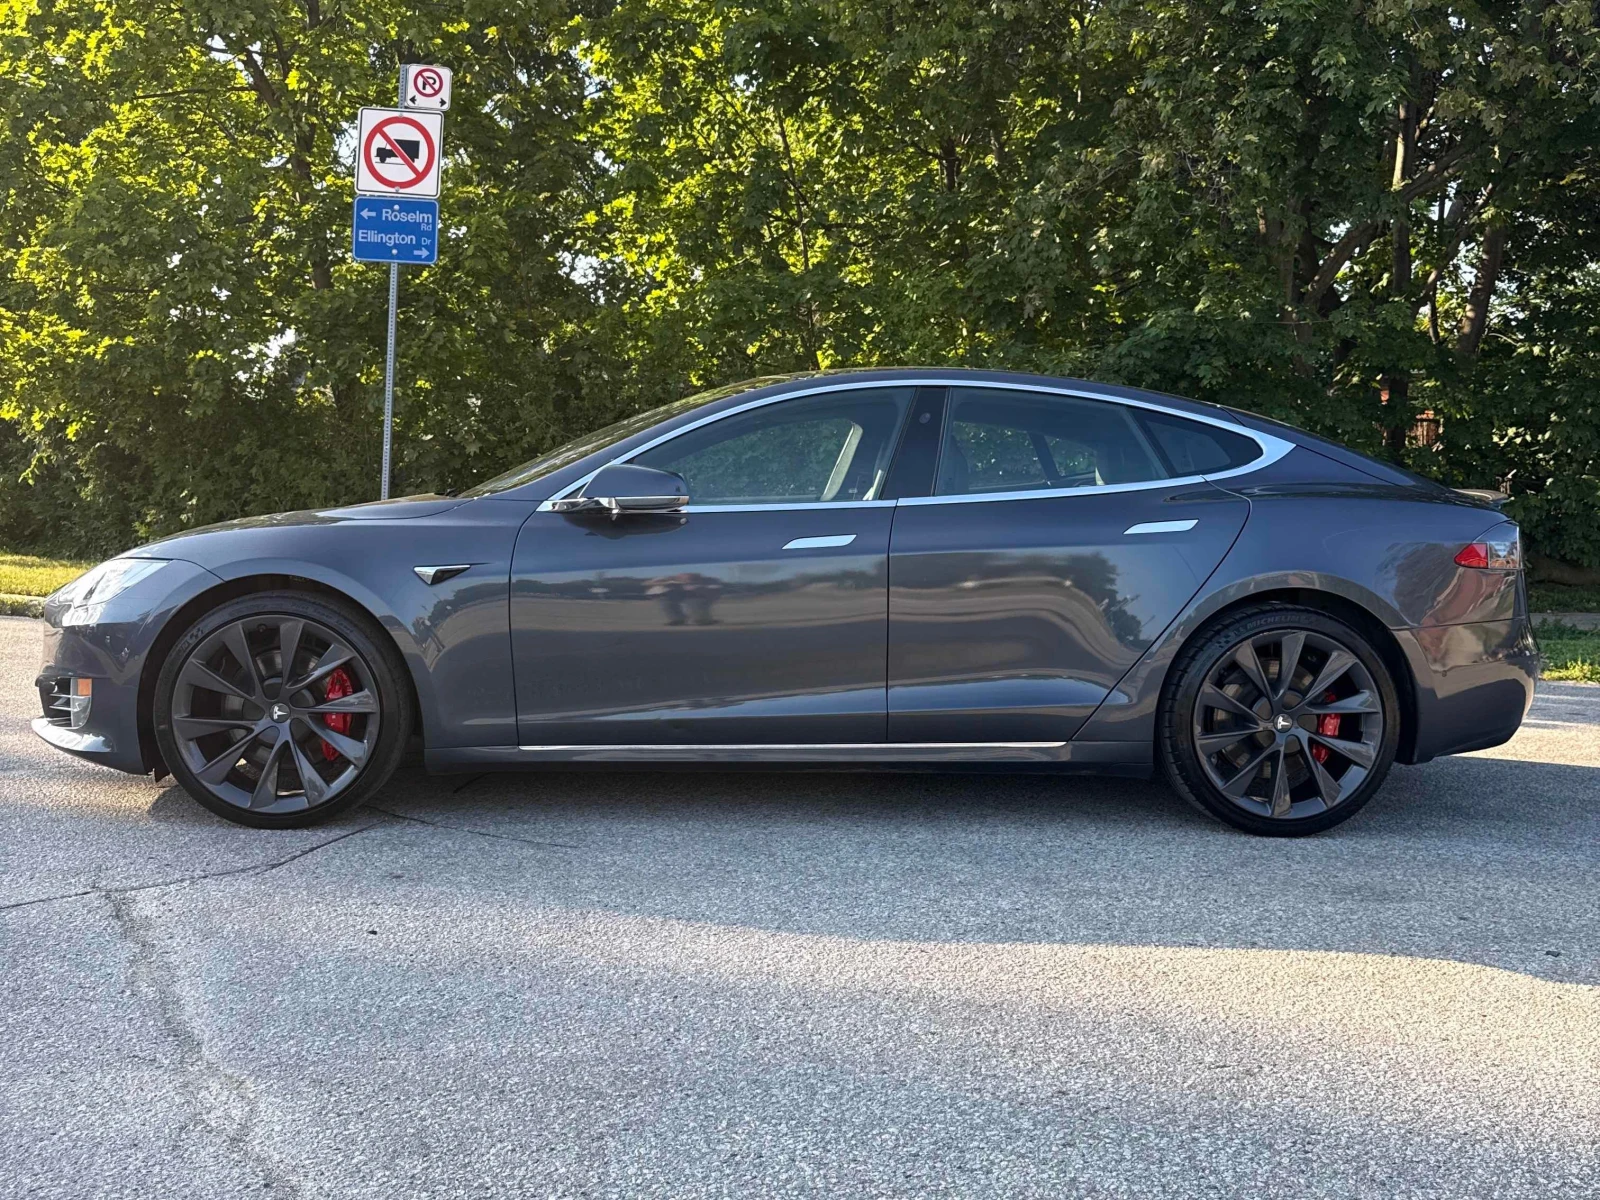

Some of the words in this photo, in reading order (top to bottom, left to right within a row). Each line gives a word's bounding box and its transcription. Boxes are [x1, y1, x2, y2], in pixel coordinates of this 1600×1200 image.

[382, 209, 432, 223] Roselm
[421, 223, 432, 231] Rd
[358, 229, 416, 247] Ellington
[1247, 615, 1299, 629] MICHELIN
